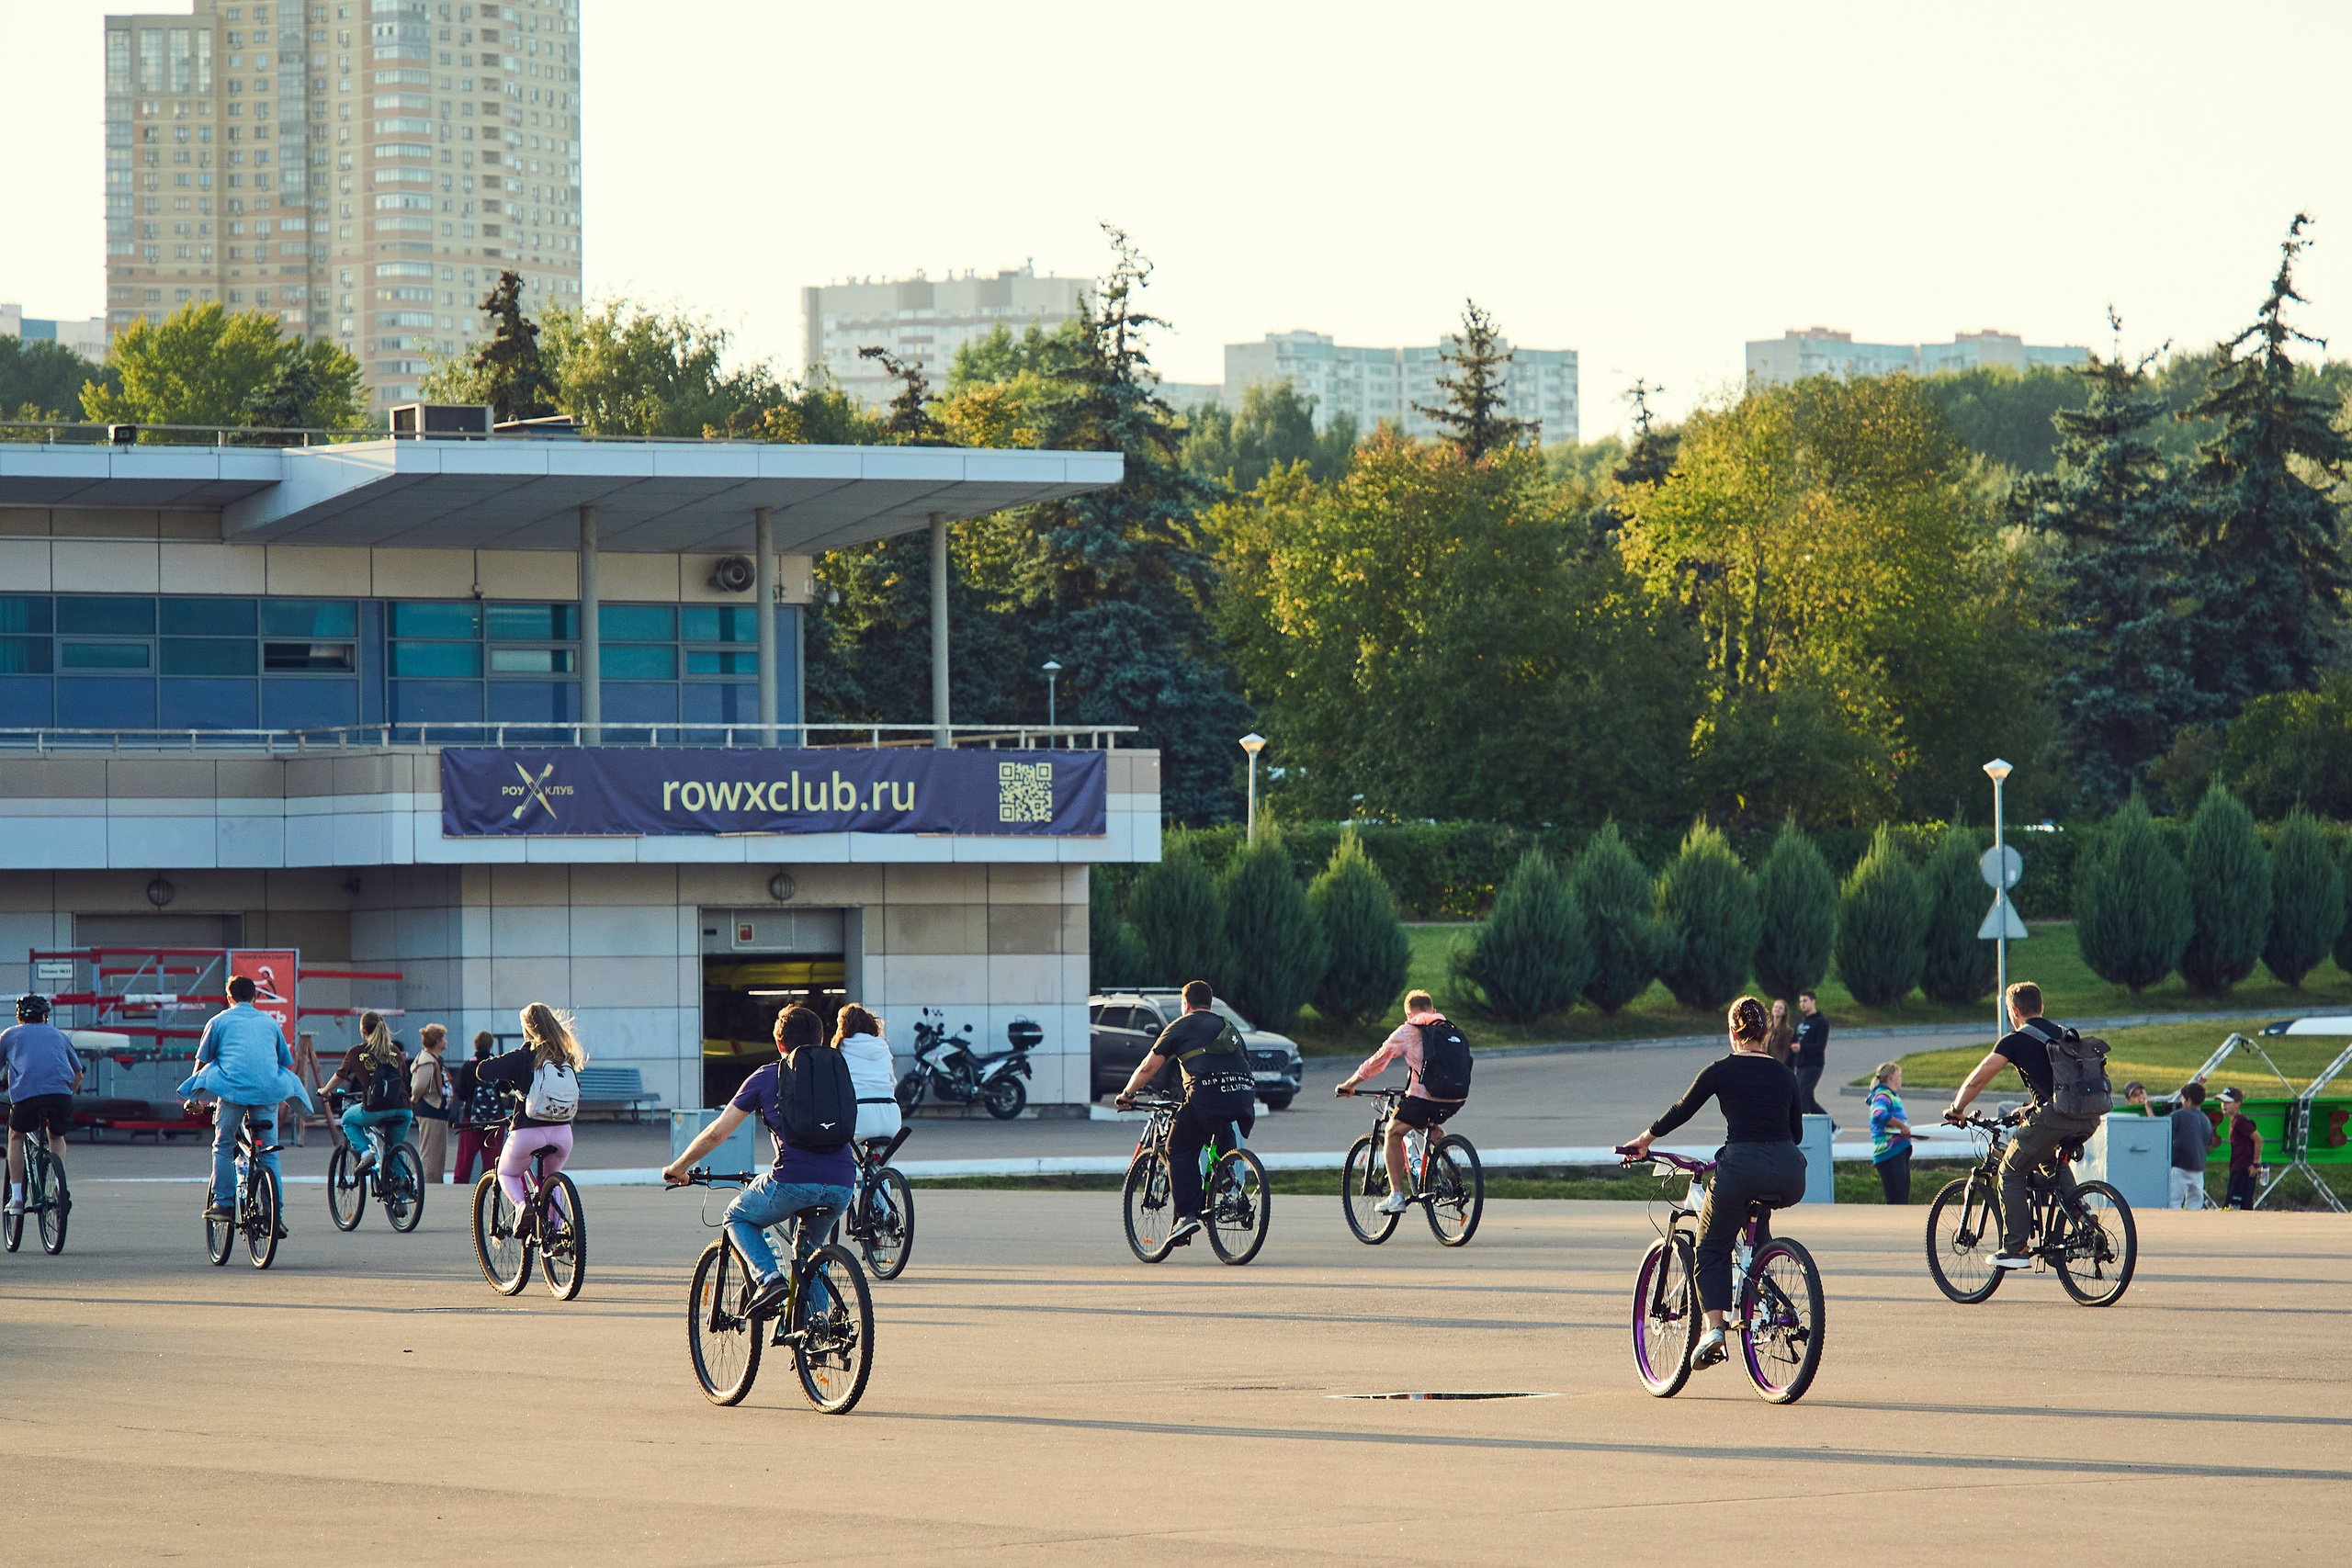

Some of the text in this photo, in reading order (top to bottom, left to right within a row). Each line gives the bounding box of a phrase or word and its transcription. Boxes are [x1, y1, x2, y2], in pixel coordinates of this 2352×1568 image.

[502, 785, 574, 796] РОУ КЛУБ
[662, 770, 915, 812] rowxclub.ru
